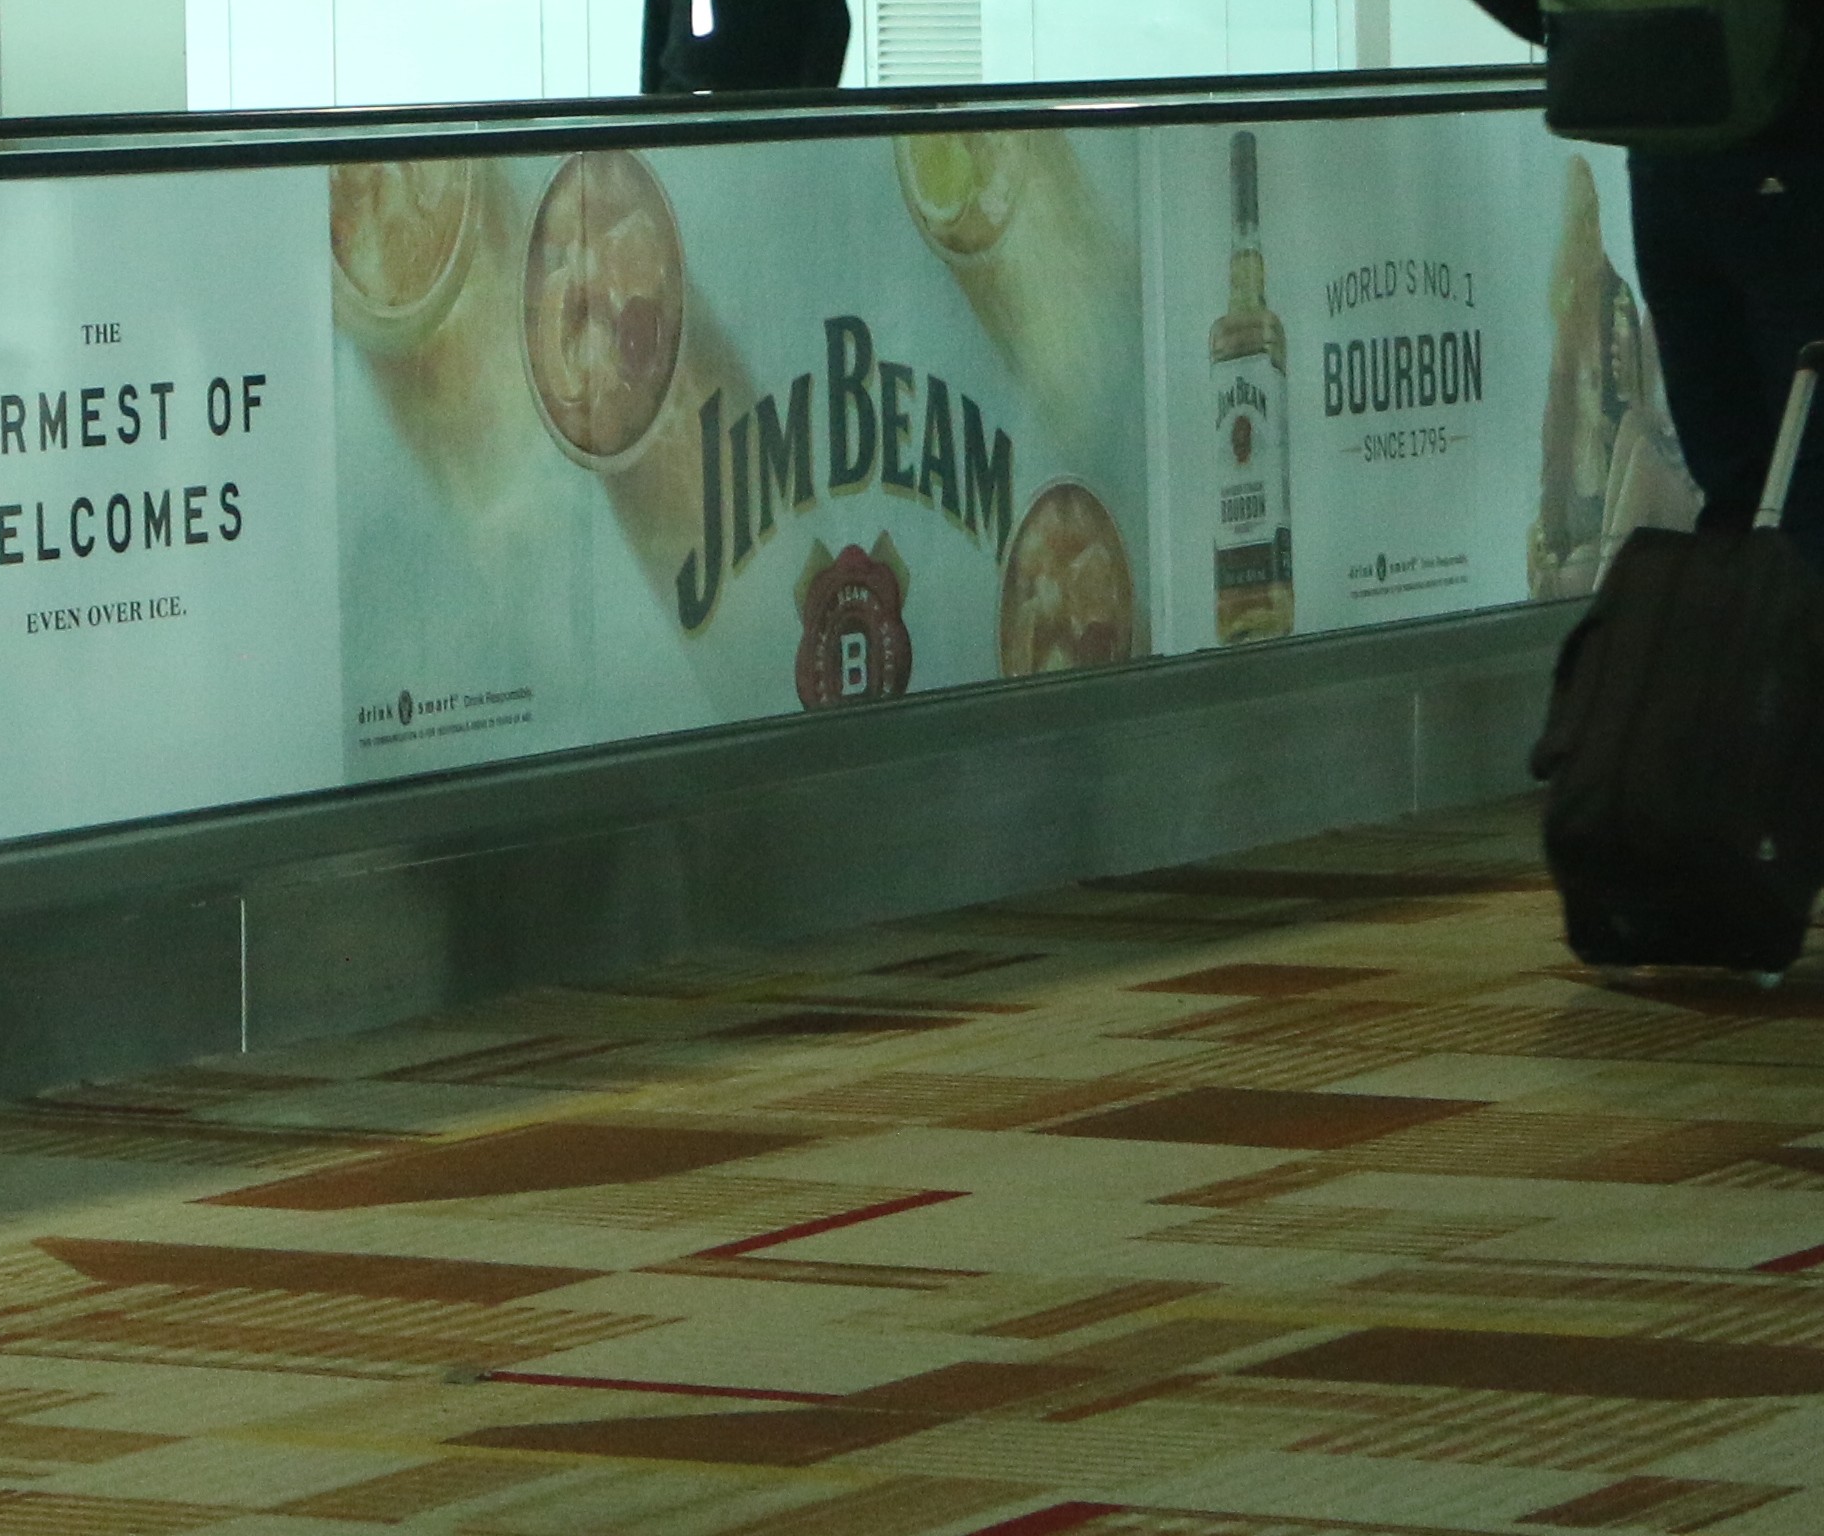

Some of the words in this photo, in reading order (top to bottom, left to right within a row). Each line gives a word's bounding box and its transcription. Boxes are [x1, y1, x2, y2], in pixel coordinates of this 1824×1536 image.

[1326, 259, 1416, 317] WORLD'S
[81, 323, 122, 345] THE
[1323, 329, 1483, 417] BOURBON
[206, 373, 267, 436] OF
[1364, 431, 1406, 462] SINCE
[1410, 426, 1447, 457] 1795
[676, 372, 817, 639] JIM
[824, 315, 1014, 568] BEAM
[27, 607, 80, 634] EVEN
[88, 601, 142, 628] OVER
[149, 596, 187, 620] ICE.
[840, 632, 868, 696] B
